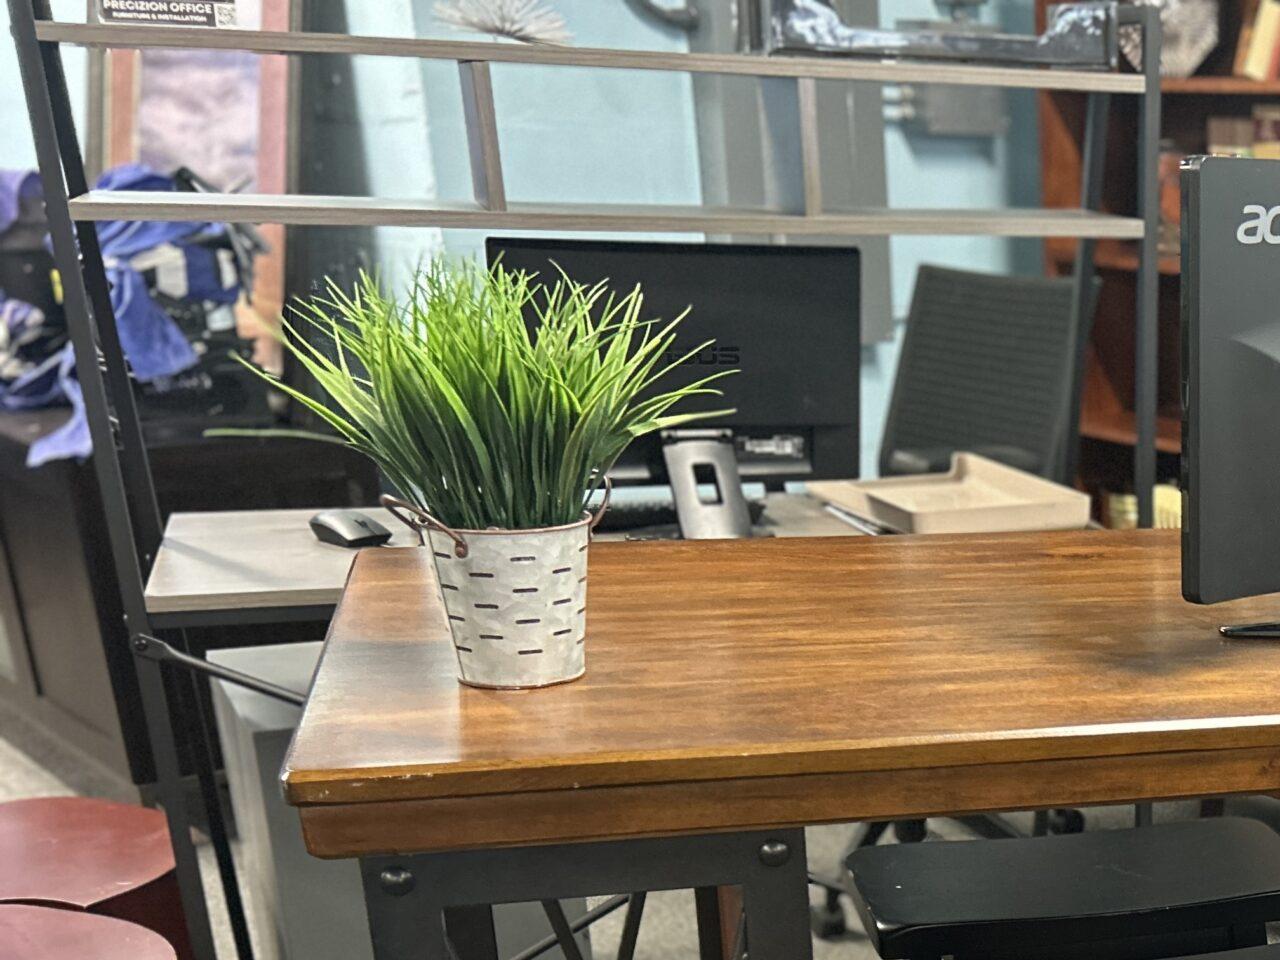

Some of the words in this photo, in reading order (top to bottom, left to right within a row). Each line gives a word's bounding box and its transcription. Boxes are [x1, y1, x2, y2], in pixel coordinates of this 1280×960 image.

[103, 0, 168, 12] PRECIZION
[171, 3, 213, 13] OFFICE
[113, 12, 150, 20] FURNITURE
[158, 14, 207, 22] INSTALLATION
